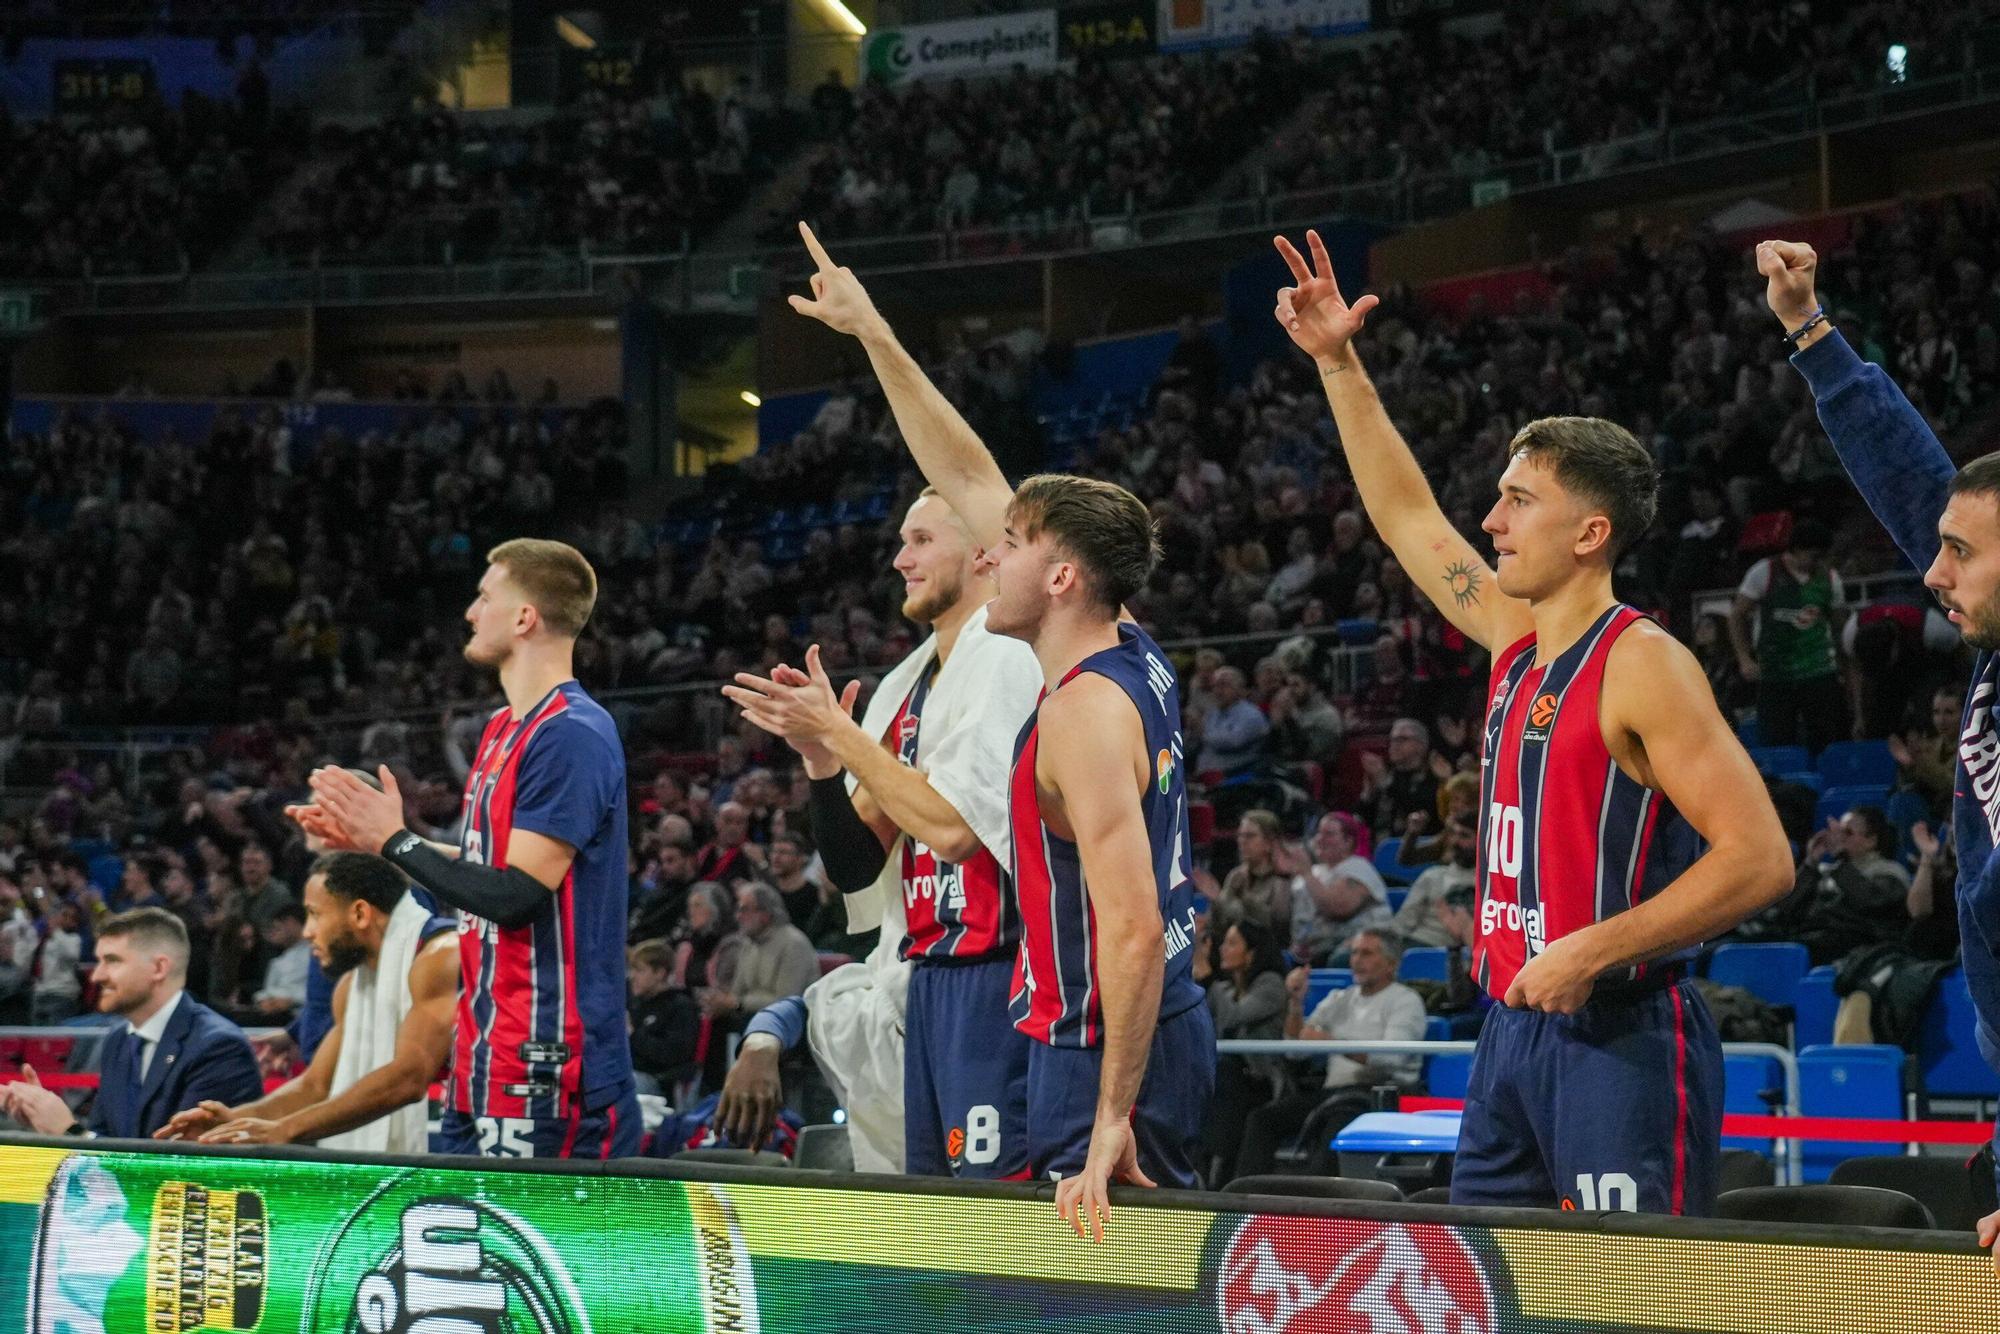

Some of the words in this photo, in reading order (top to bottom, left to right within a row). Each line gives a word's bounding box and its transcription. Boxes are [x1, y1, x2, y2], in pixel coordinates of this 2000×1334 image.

[1486, 802, 1523, 877] 10
[475, 1117, 535, 1158] 25
[965, 1105, 1001, 1164] 8
[1576, 1173, 1638, 1213] 10
[154, 1187, 181, 1331] ERFRISCHEND
[182, 1190, 206, 1324] EINZIGARTIG
[207, 1203, 232, 1309] SPRITZIG
[236, 1218, 263, 1287] KLAR
